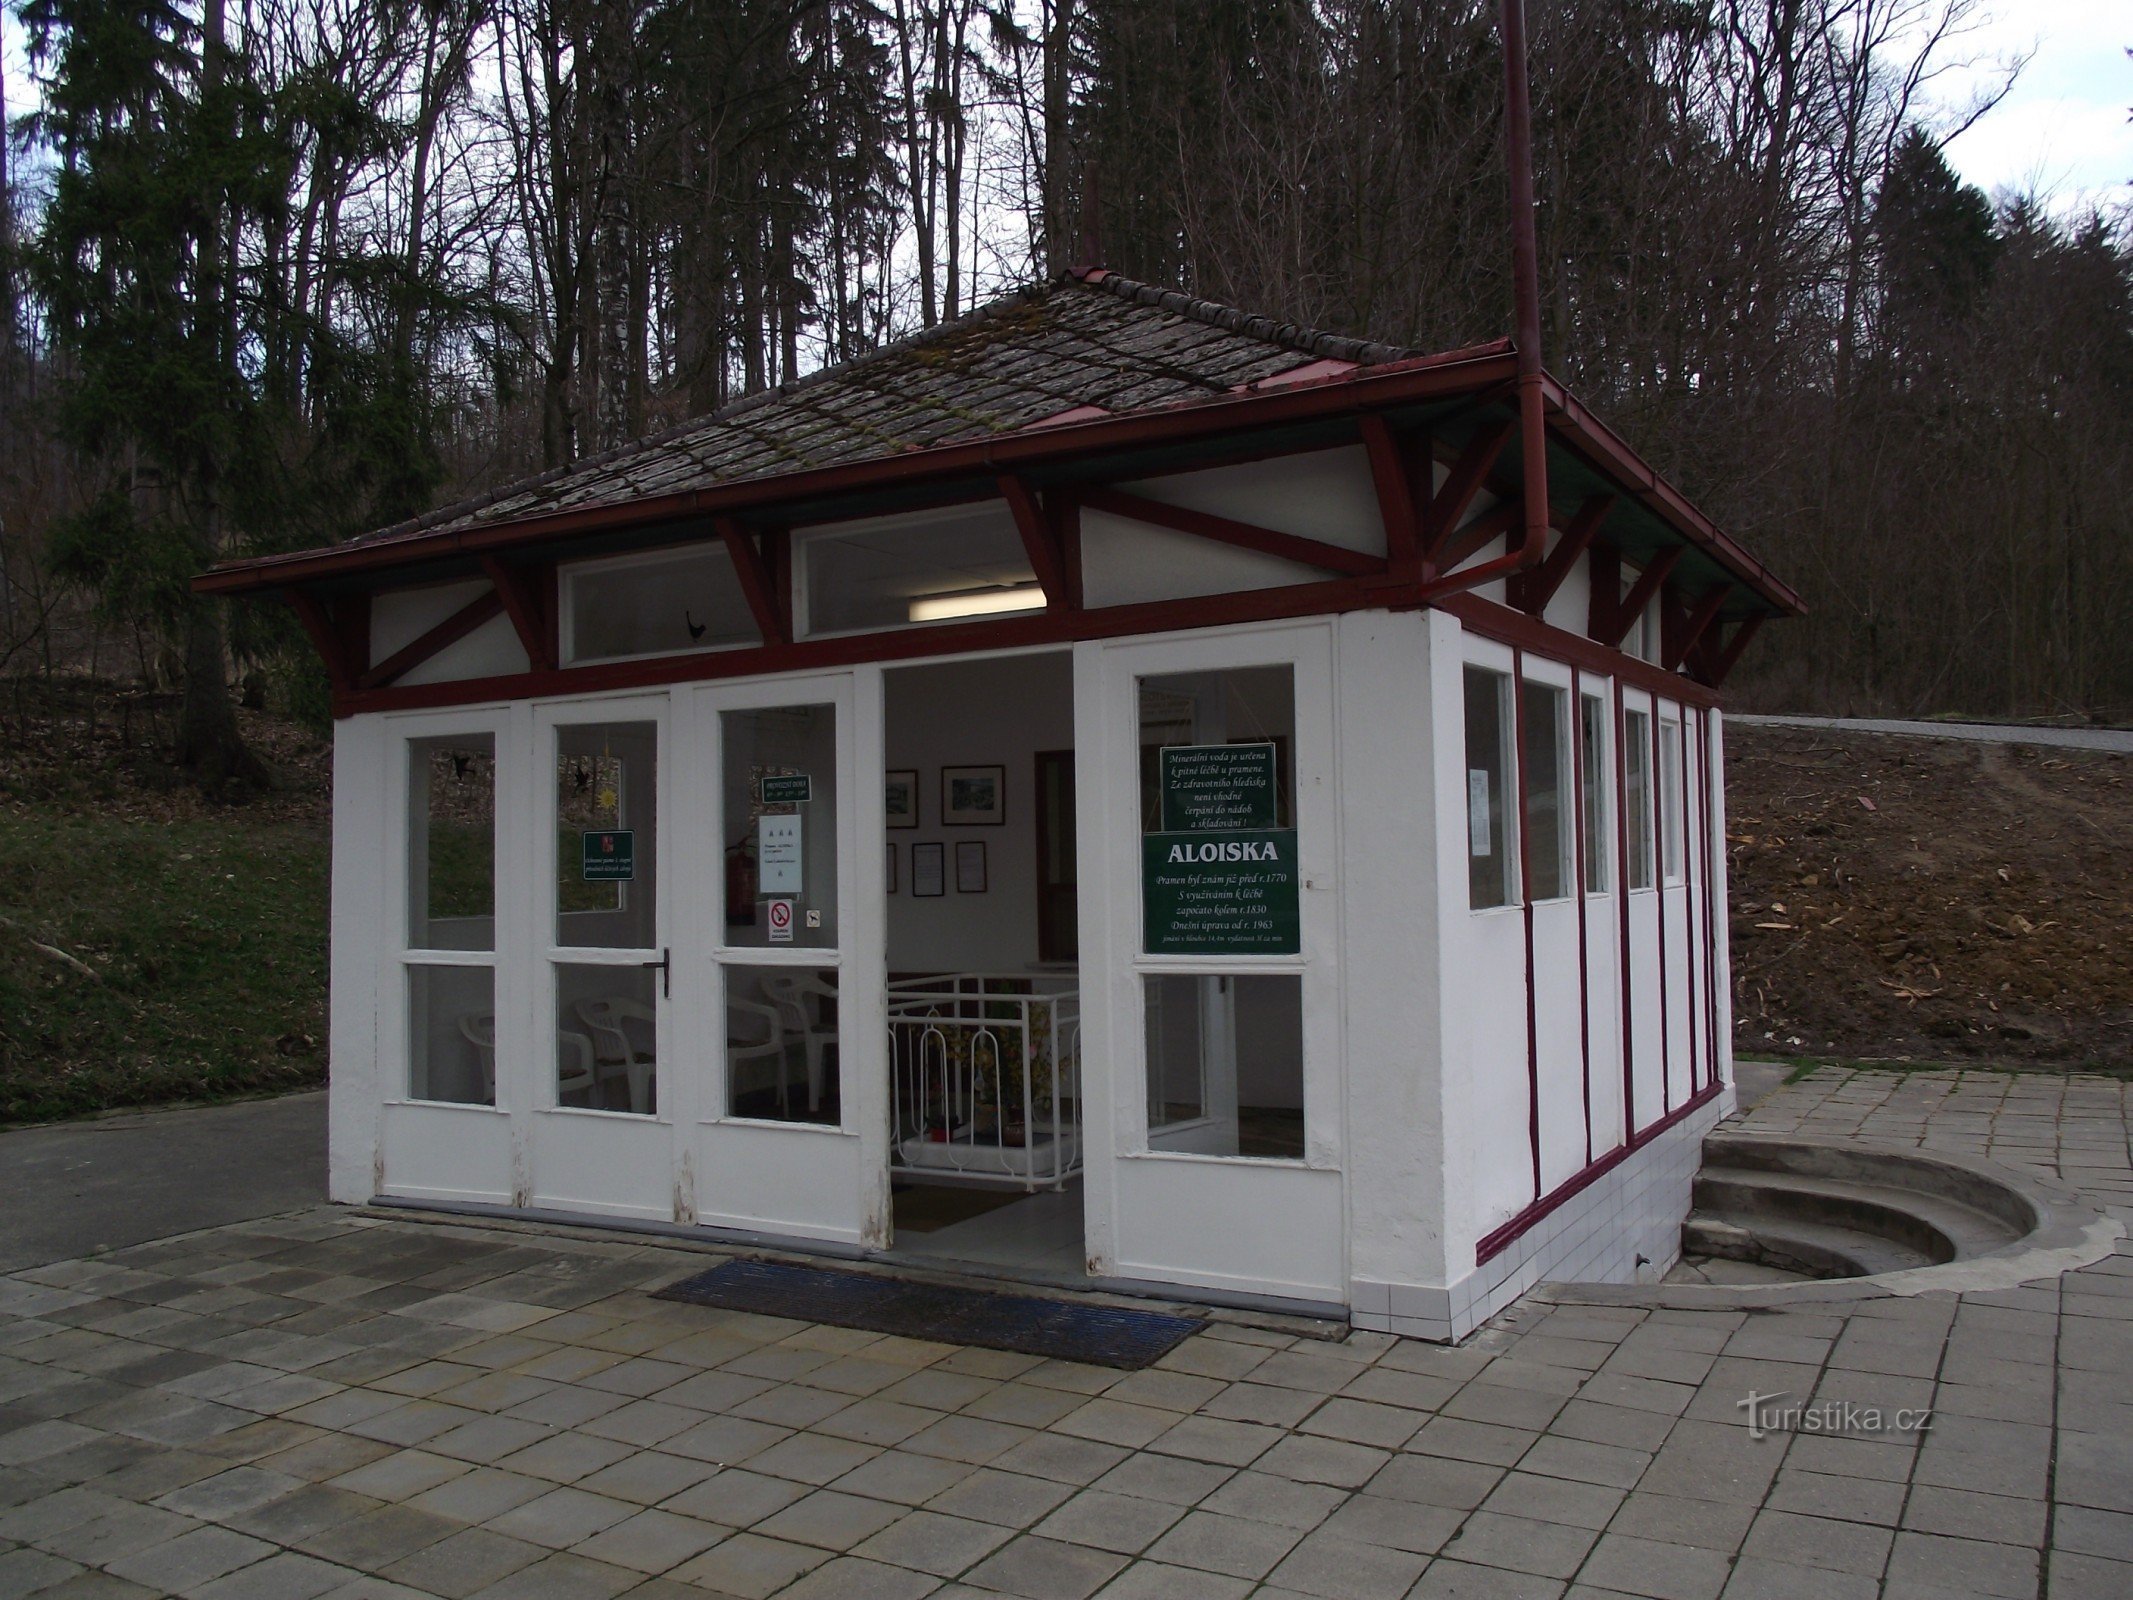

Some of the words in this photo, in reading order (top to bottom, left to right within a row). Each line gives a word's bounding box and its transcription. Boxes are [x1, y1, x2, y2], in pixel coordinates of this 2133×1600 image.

[1170, 753, 1207, 763] Minerální
[1210, 752, 1228, 760] voda
[1240, 752, 1266, 760] určena
[1172, 767, 1179, 777] k
[1177, 766, 1198, 778] pitné
[1200, 765, 1219, 774] léčbě
[1229, 767, 1264, 775] pramene.
[1171, 781, 1180, 789] Ze
[1183, 778, 1230, 788] zdravotního
[1233, 777, 1266, 788] hlediska
[1214, 791, 1241, 800] vhodné
[1185, 807, 1213, 817] čerpání
[1216, 805, 1225, 814] do
[1228, 804, 1252, 813] nádob
[1198, 818, 1241, 829] skladování
[1168, 842, 1278, 863] ALOISKA
[1156, 876, 1185, 885] Pramen
[1188, 874, 1202, 886] byl
[1203, 875, 1224, 883] znám
[1226, 874, 1236, 886] již
[1239, 873, 1259, 885] před
[1186, 889, 1233, 902] využíváním
[1236, 890, 1244, 900] k
[1243, 888, 1264, 898] léčbě
[1176, 905, 1212, 917] započato
[1214, 904, 1237, 916] kolem
[1171, 921, 1199, 929] Dnešní
[1202, 922, 1229, 931] úprava
[1232, 920, 1244, 929] od
[1253, 921, 1272, 929] 1963
